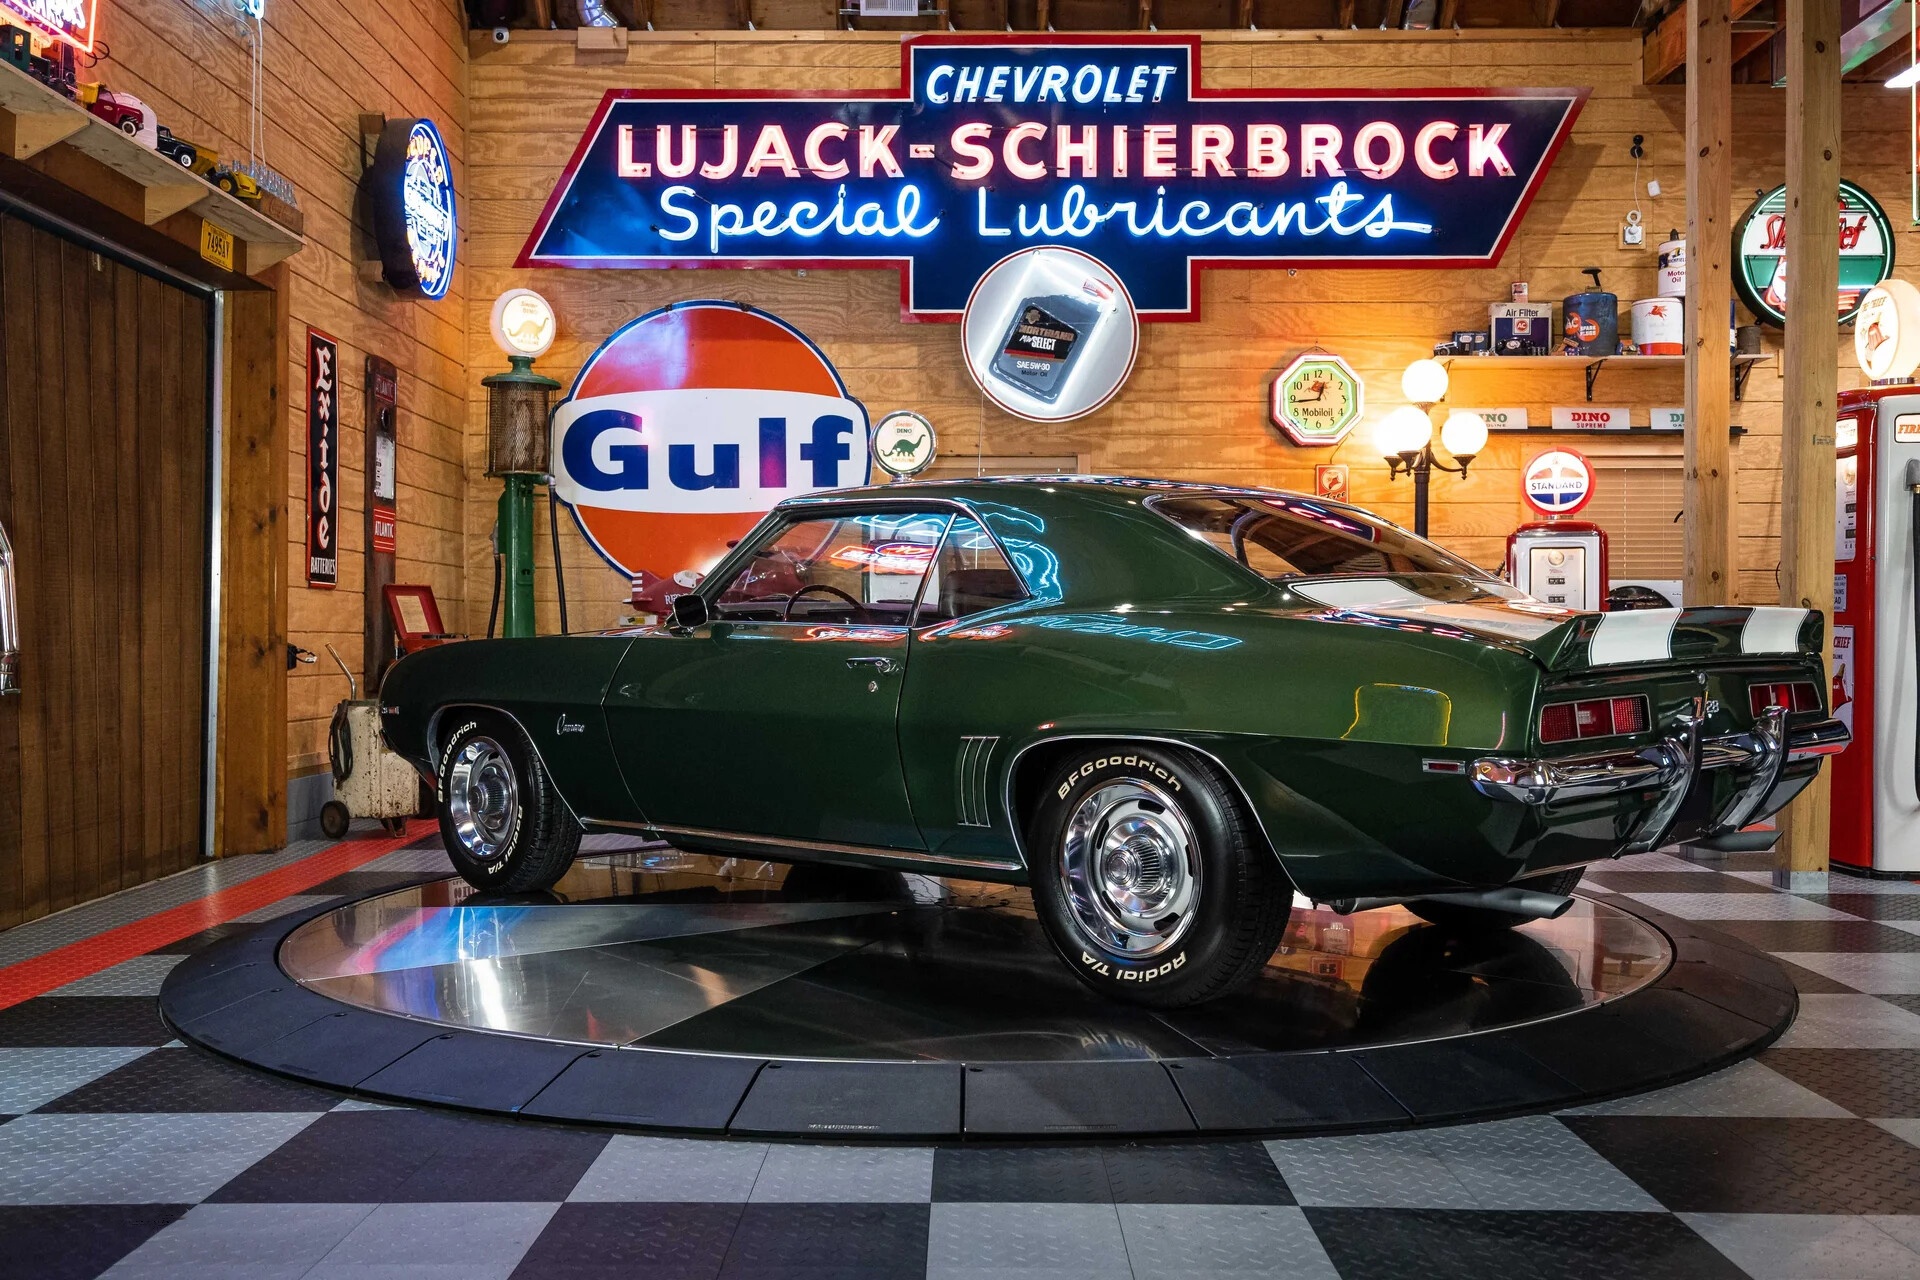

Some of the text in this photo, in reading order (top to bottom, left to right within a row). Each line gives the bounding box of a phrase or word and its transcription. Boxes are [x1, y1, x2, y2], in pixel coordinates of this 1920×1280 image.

[926, 65, 1177, 103] CHEVROLET
[617, 121, 1516, 180] LUJACK-SCHIERBROCK
[658, 181, 1433, 253] Special Lubricants
[1505, 309, 1539, 317] Air Filter
[1566, 316, 1579, 329] AC
[1032, 335, 1057, 351] SELECT
[1016, 360, 1051, 371] SAE 5W-30
[1303, 373, 1309, 381] 11
[1314, 369, 1323, 378] 12
[1329, 373, 1333, 381] 1
[1293, 381, 1302, 390] 10
[1338, 381, 1343, 390] 2
[1341, 394, 1347, 404] 3
[1293, 408, 1299, 416] 8
[1302, 407, 1333, 416] Mobiloil
[1338, 408, 1344, 416] 4
[1303, 418, 1308, 426] 7
[1330, 416, 1335, 426] 5
[1571, 412, 1611, 422] DINO
[1315, 420, 1321, 429] 6
[316, 346, 332, 549] Exide
[562, 409, 854, 491] Gulf
[1531, 481, 1583, 490] STANDARD
[374, 520, 394, 539] ATLANTIC
[310, 557, 336, 576] BATTERIES
[437, 721, 477, 802] BFGoodrich
[1058, 755, 1183, 800] BFGoodrich
[487, 805, 523, 875] Radial T/A
[1081, 951, 1187, 983] Radial T/A
